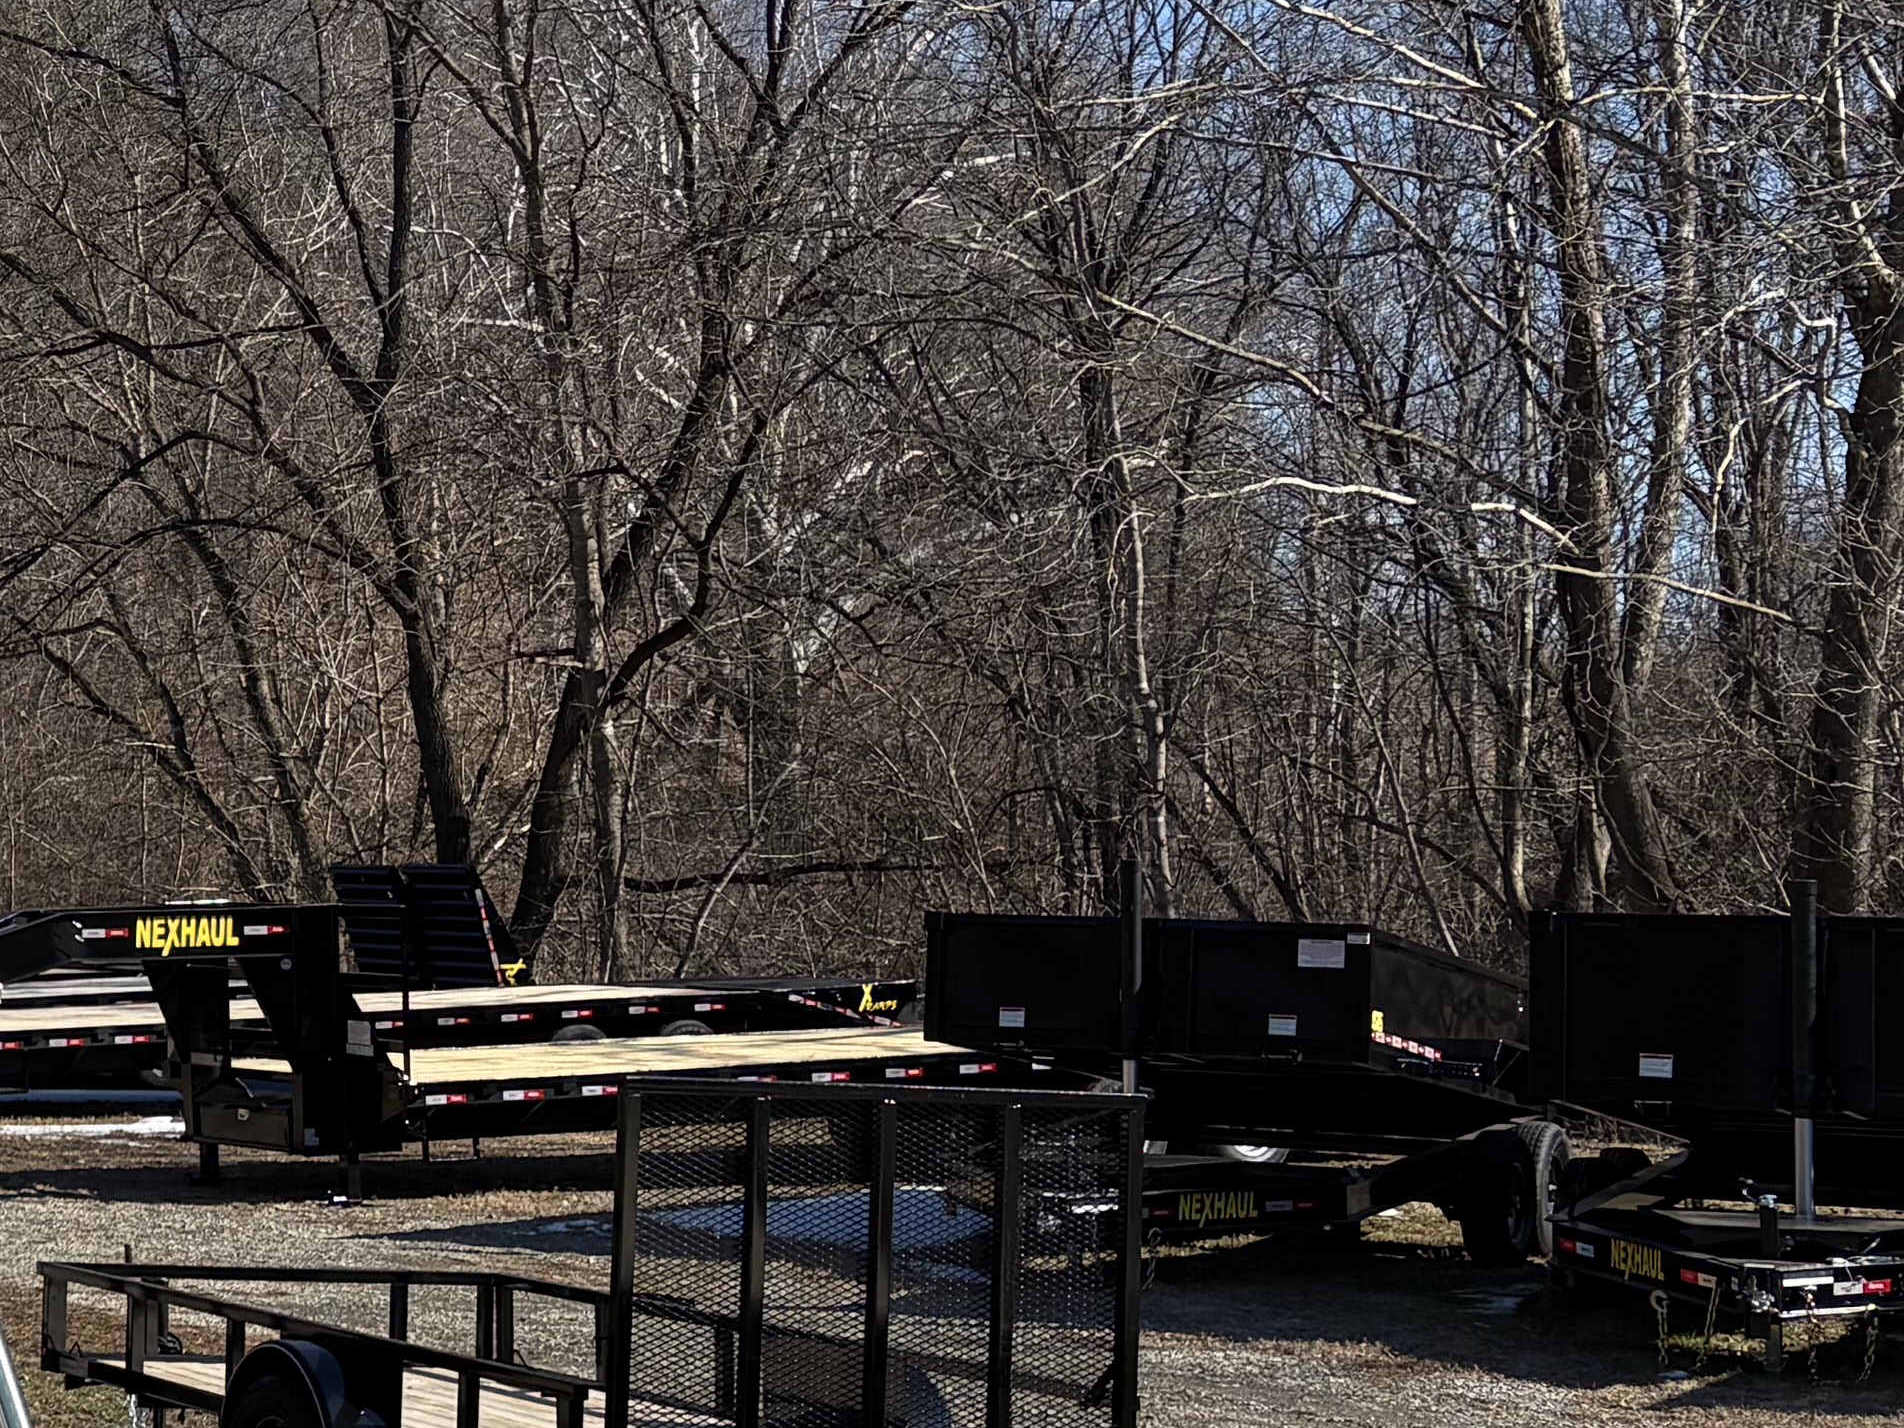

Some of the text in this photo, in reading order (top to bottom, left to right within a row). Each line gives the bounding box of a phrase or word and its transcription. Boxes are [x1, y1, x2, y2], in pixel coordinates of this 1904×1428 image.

[135, 915, 240, 957] NEXHAUL
[1178, 1190, 1258, 1228] NEXHAUL
[1610, 1238, 1665, 1281] NEXHAUL
